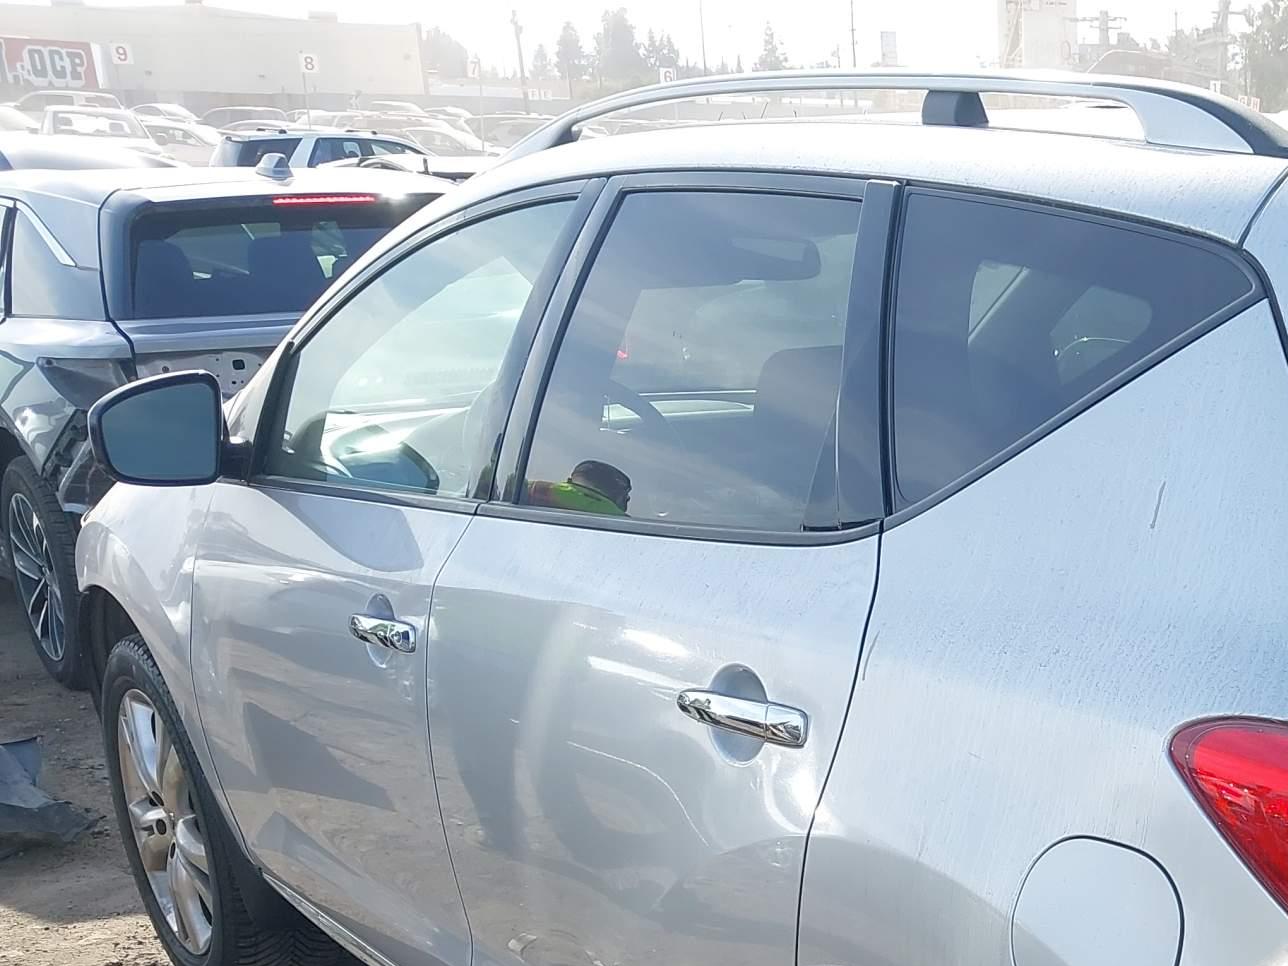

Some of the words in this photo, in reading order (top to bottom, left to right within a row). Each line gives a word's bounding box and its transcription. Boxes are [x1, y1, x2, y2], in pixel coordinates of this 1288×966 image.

[115, 46, 128, 61] 9
[304, 56, 314, 71] 8
[470, 60, 479, 75] 7
[664, 70, 673, 82] 6
